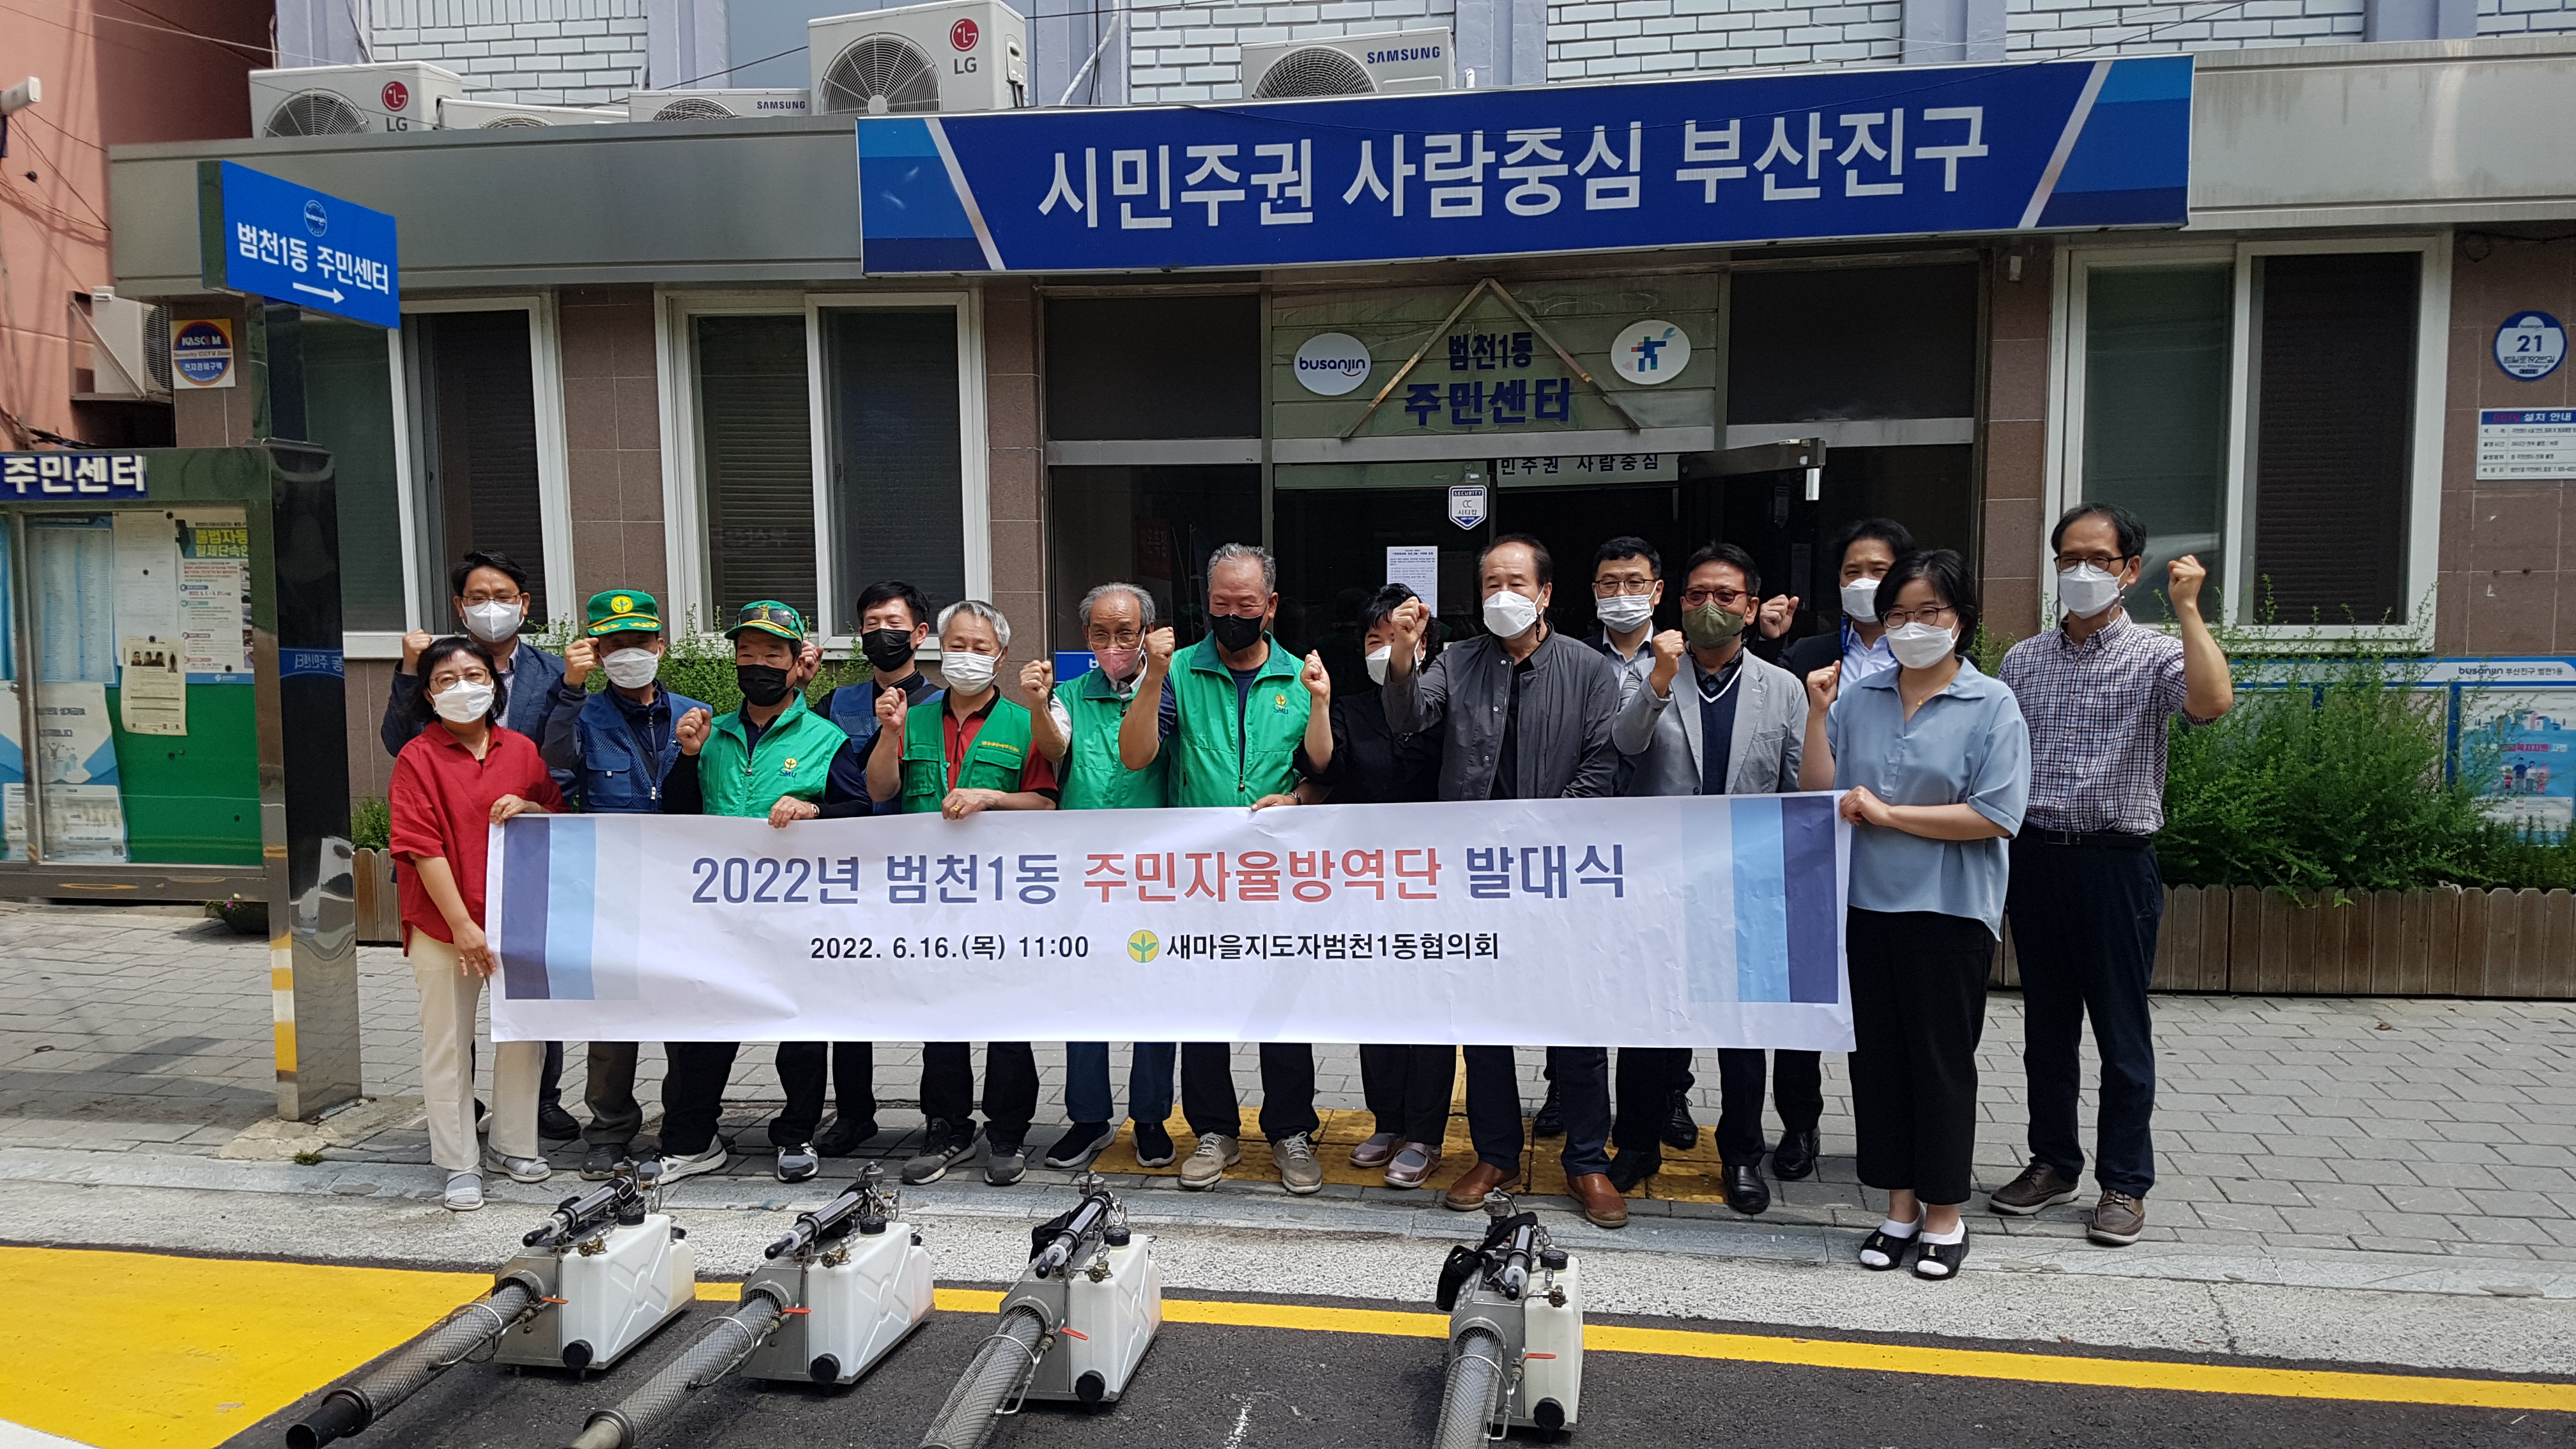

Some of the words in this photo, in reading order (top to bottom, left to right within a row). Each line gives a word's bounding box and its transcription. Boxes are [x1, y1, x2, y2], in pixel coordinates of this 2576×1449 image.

[1367, 46, 1440, 64] SAMSUNG
[954, 57, 977, 75] LG
[756, 100, 806, 110] SAMSUNG
[386, 117, 408, 132] LG
[1038, 139, 1314, 229] 시민주권
[1343, 121, 1642, 218] 사람중심
[1676, 106, 1988, 203] 부산진구
[237, 222, 308, 273] 범천1동
[317, 245, 388, 295] 주민센터
[1448, 332, 1533, 371] 범천1동
[2517, 335, 2543, 352] 21
[1299, 356, 1366, 372] busanjin
[1405, 378, 1570, 426] 주민센터
[2524, 413, 2546, 422] 설치
[2550, 413, 2572, 421] 안내
[1577, 454, 1659, 472] 사람중심
[3, 455, 147, 494] 주민센터
[2458, 666, 2503, 676] busanjin
[692, 856, 859, 905] 2022년
[886, 854, 1060, 905] 범천1동
[1084, 848, 1442, 903] 주민자율방역단
[1466, 844, 1625, 899] 발대식
[811, 937, 882, 959] 2022.
[1019, 935, 1089, 958] 11:00
[1166, 932, 1500, 960] 새마을지도자범천1동협의회
